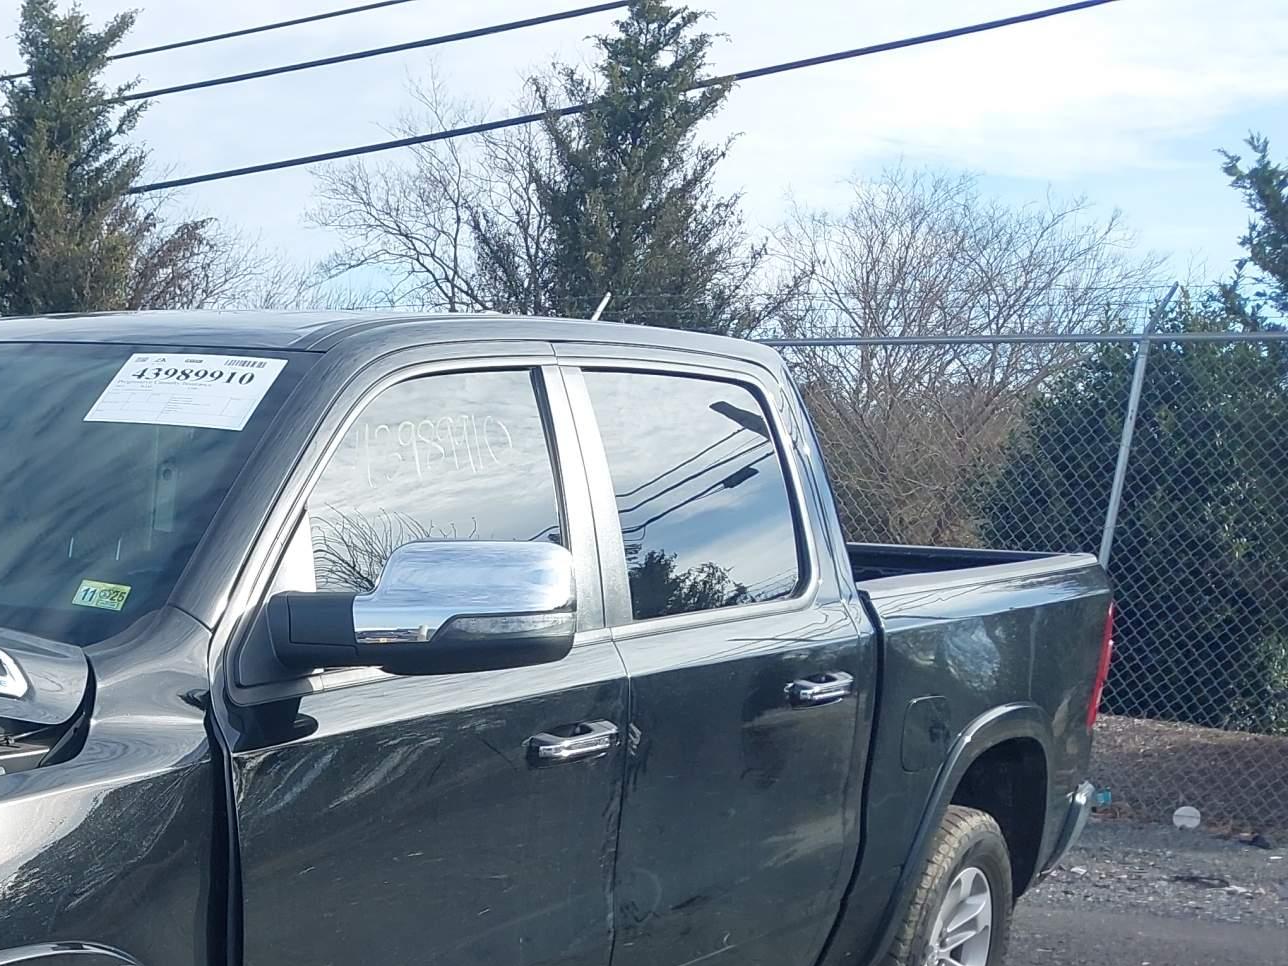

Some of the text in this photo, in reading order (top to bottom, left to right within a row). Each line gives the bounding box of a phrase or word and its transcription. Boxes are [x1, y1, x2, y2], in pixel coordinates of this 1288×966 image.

[132, 368, 255, 385] 43989910
[81, 587, 127, 602] 11 25
